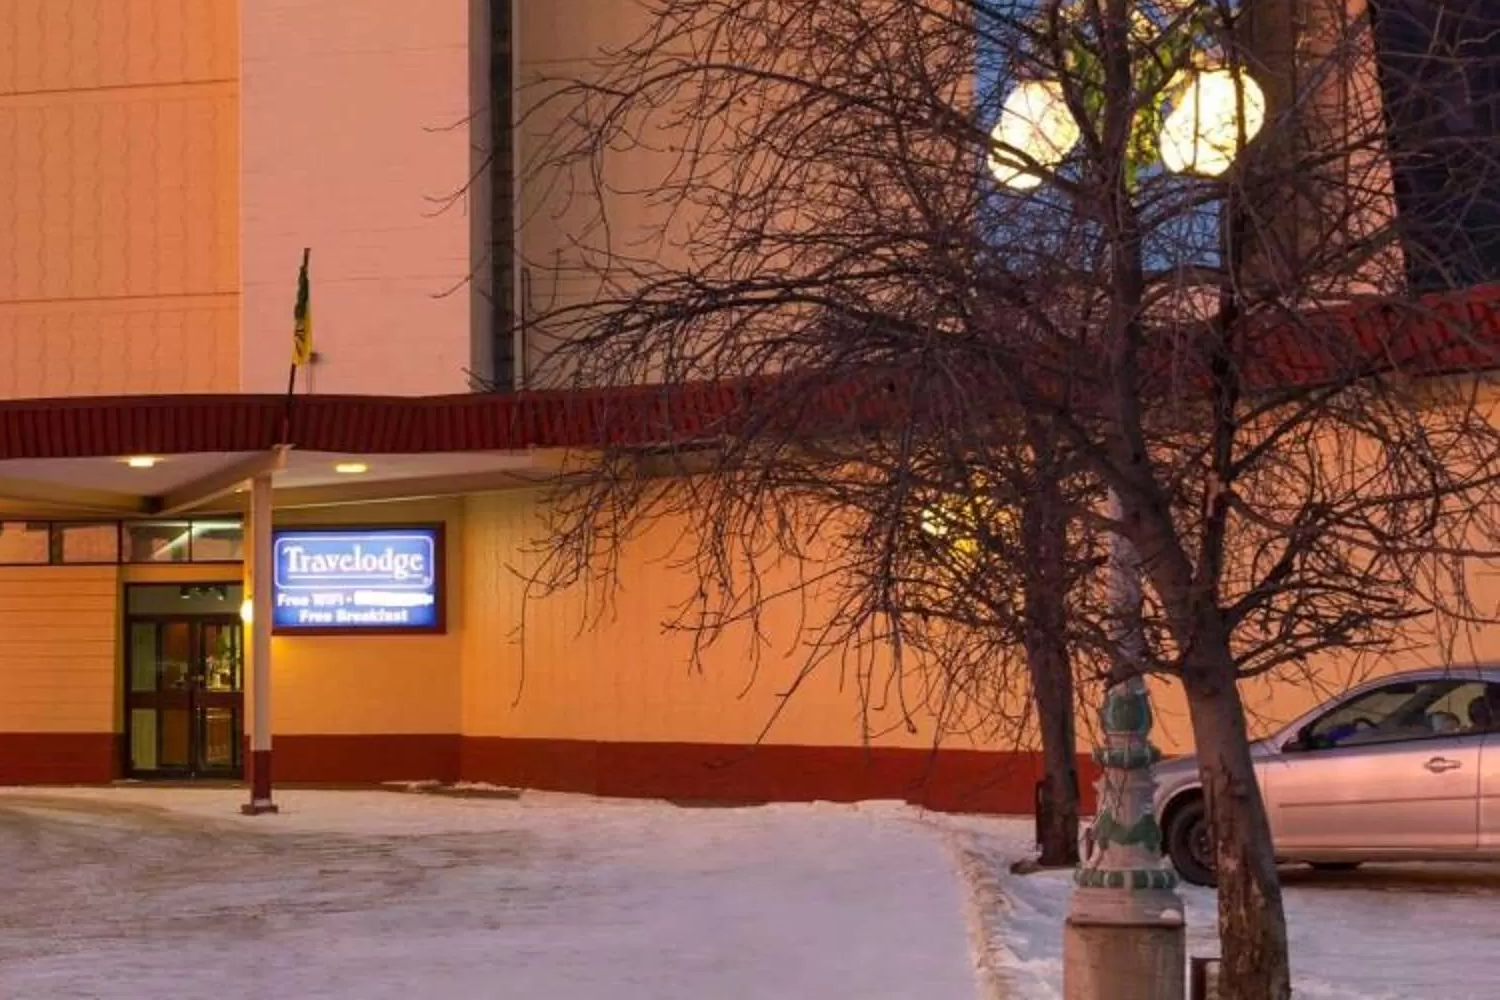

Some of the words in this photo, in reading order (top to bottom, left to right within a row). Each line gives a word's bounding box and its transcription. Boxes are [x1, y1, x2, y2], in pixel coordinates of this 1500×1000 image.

[283, 544, 424, 580] Travelodge
[299, 608, 333, 623] Free
[335, 607, 409, 624] Breakfast
